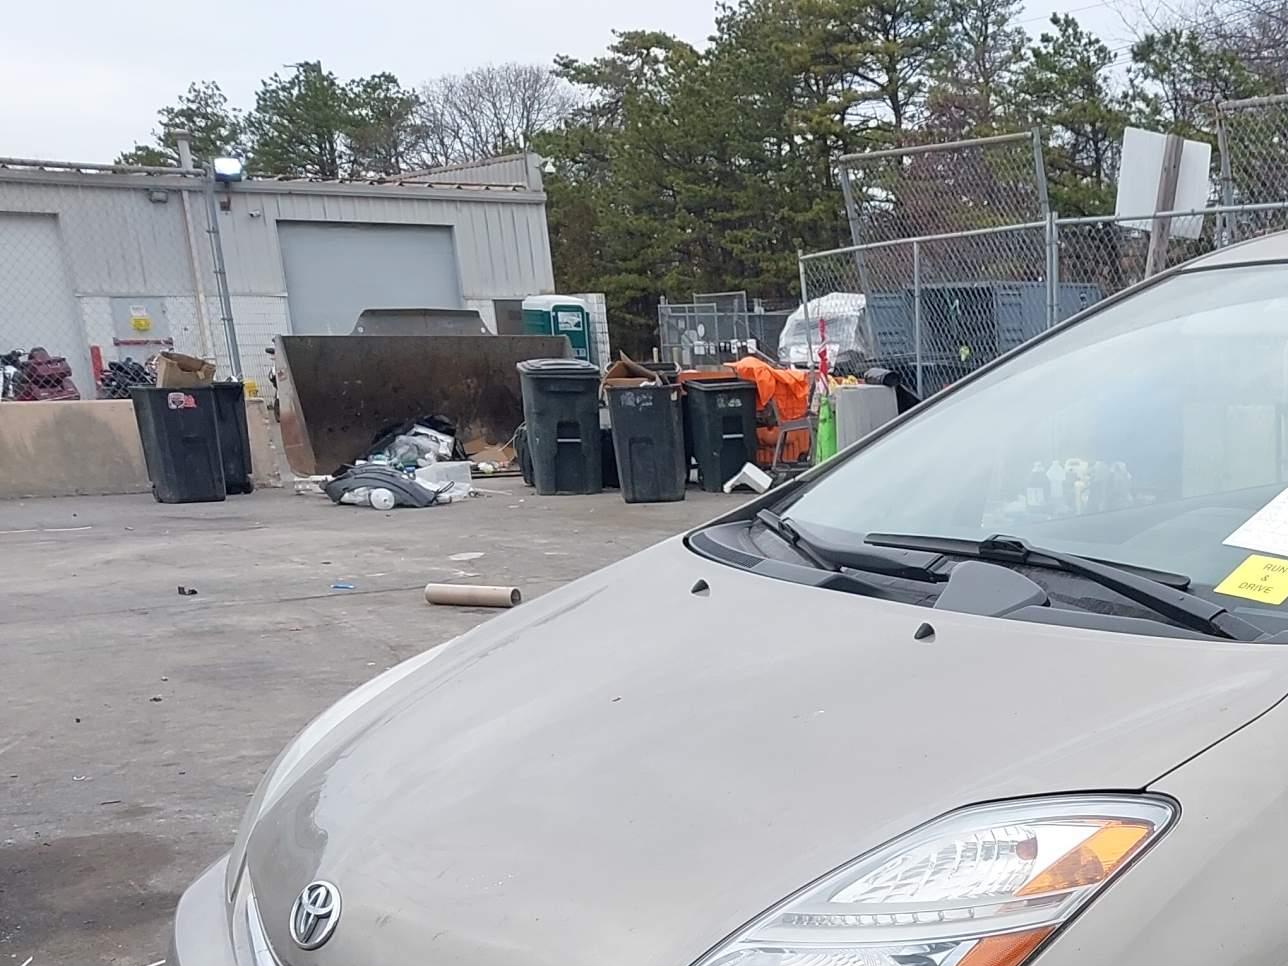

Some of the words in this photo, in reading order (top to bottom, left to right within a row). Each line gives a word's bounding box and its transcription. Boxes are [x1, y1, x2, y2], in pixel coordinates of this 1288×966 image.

[1263, 563, 1288, 574] RUN
[1260, 574, 1270, 582] &
[1238, 581, 1273, 594] DRIVE
